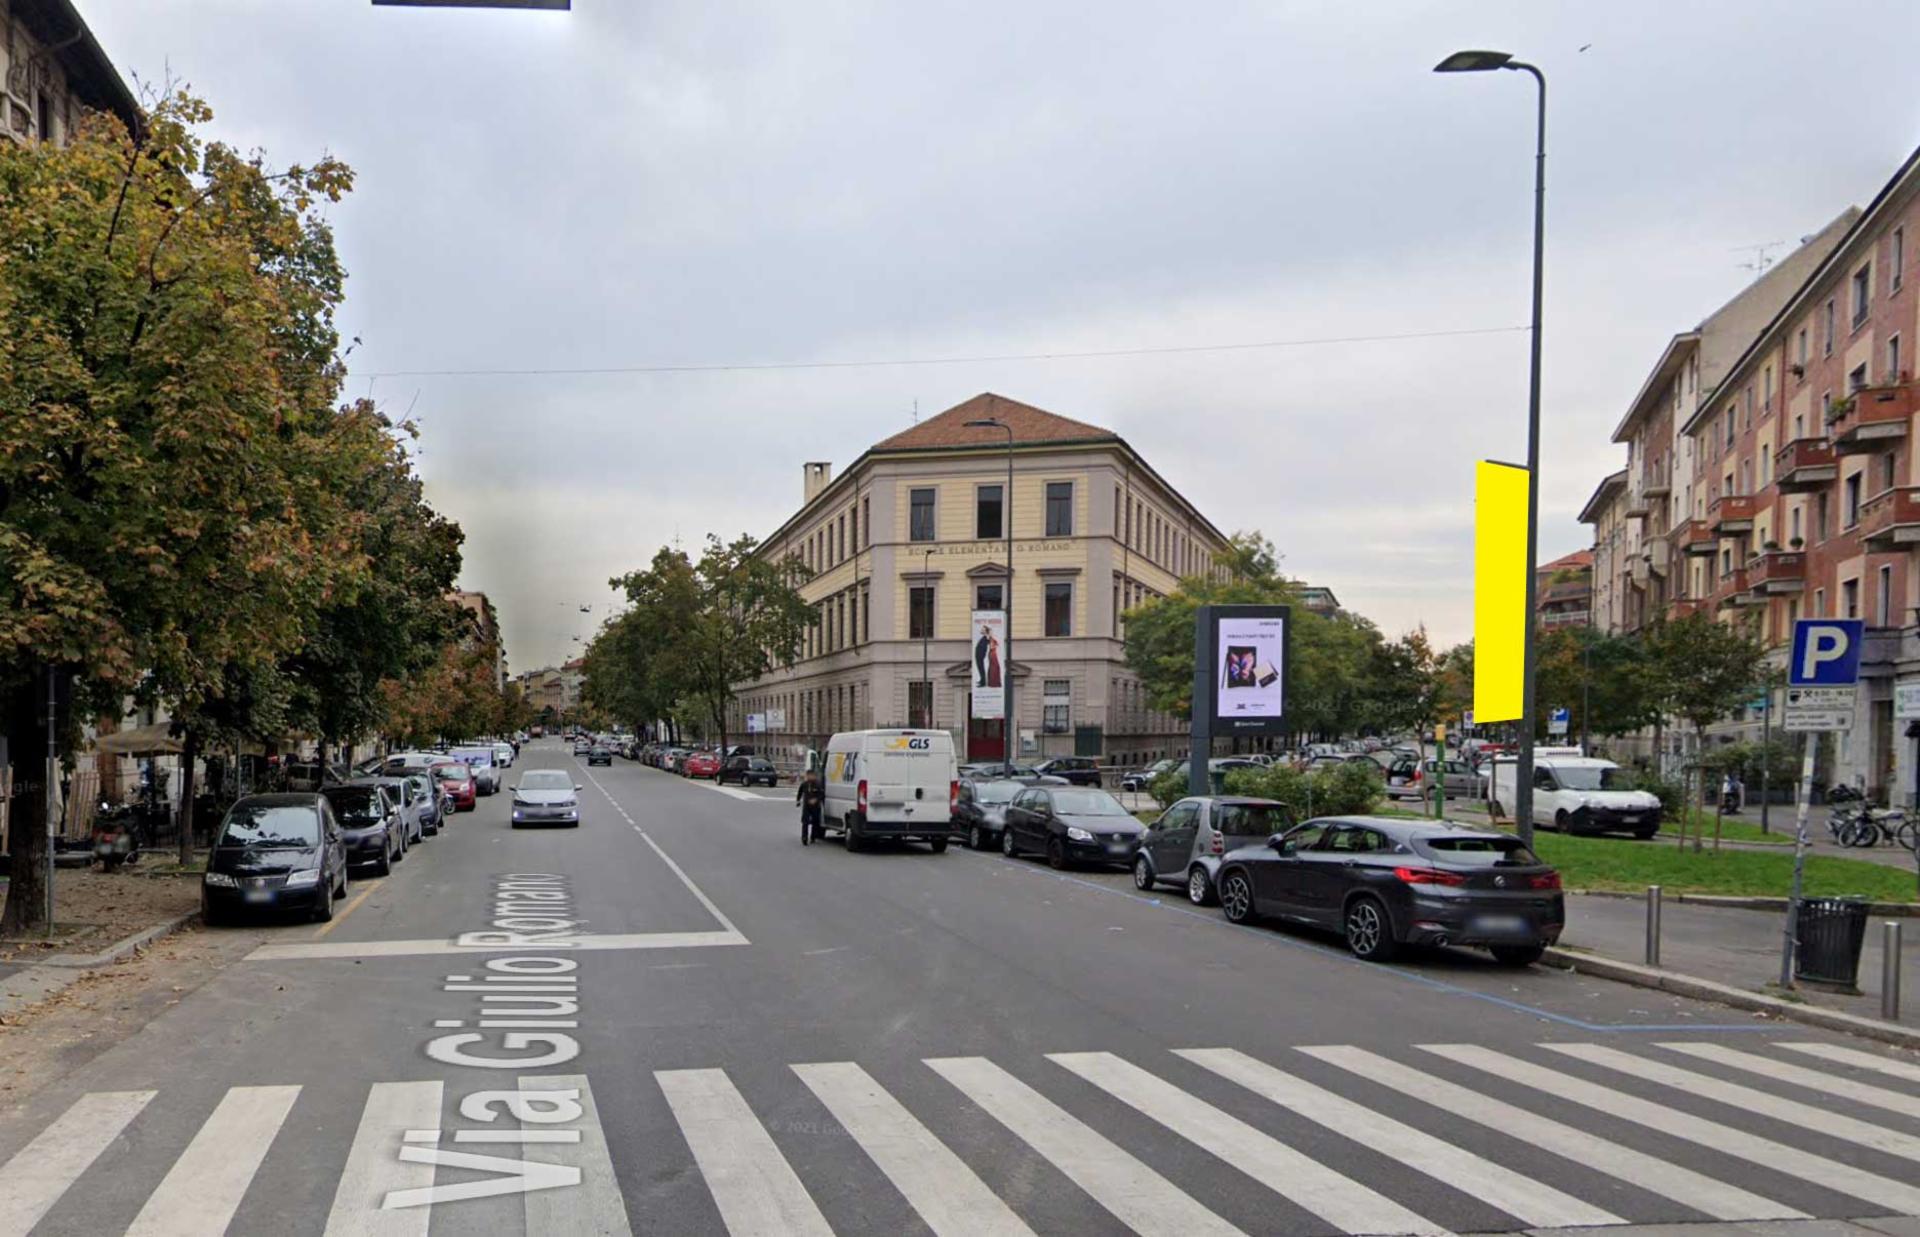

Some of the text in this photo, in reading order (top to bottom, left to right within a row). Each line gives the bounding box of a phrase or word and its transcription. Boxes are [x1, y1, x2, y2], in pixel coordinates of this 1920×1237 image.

[948, 543, 1012, 555] ELEMENTAR
[1802, 626, 1849, 679] P
[908, 738, 931, 750] GLS
